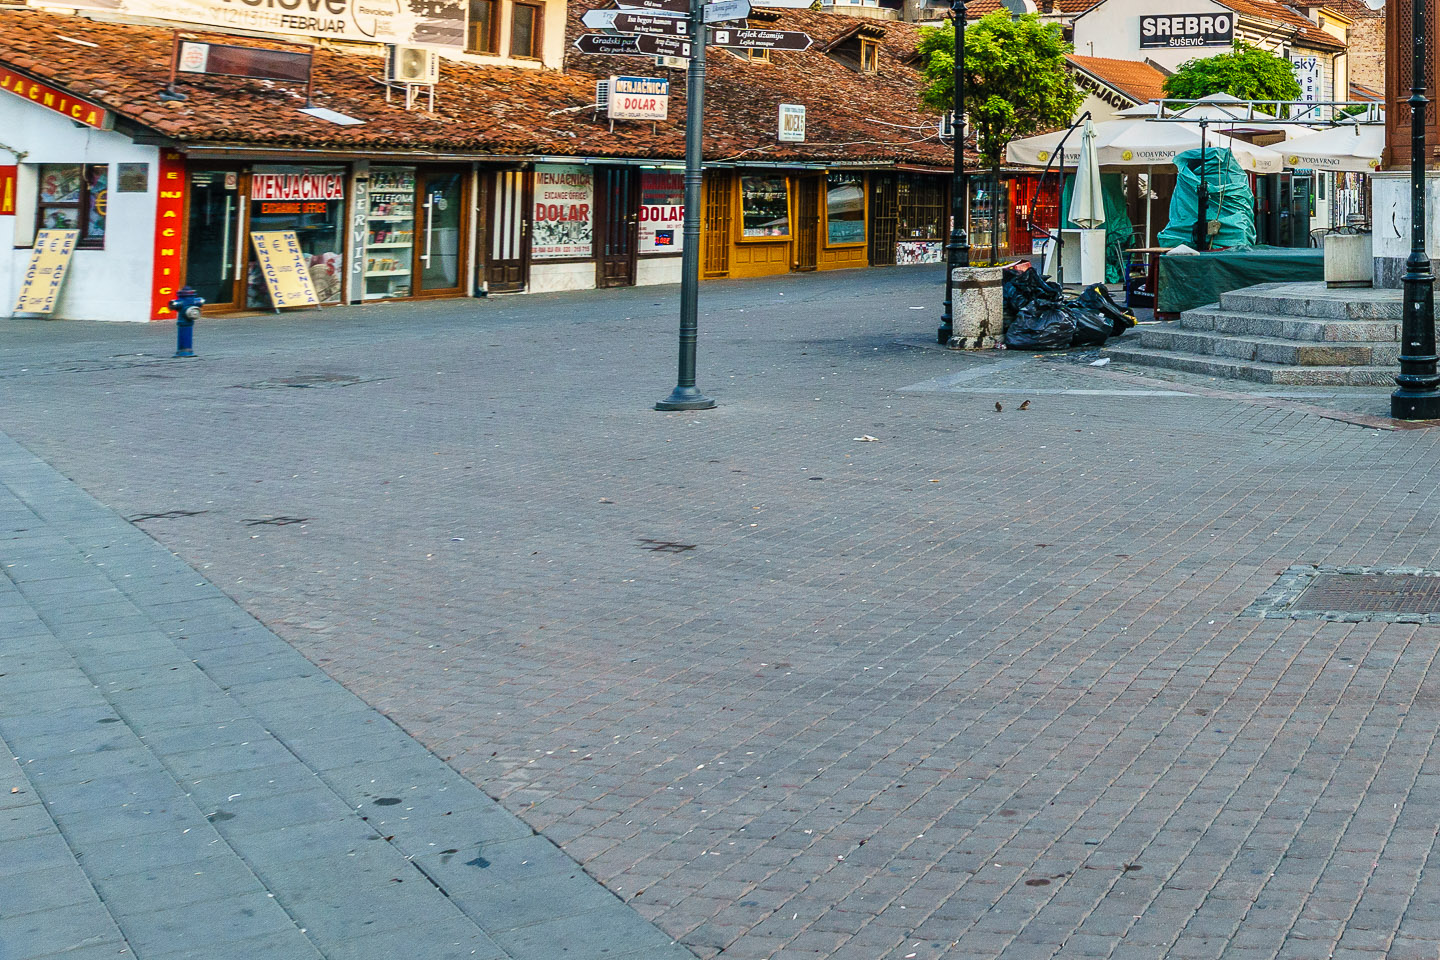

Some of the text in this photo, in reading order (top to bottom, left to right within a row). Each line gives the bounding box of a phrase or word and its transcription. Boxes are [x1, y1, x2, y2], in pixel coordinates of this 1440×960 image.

[281, 14, 346, 34] FEBRUAR
[1142, 15, 1230, 37] SREBRO
[592, 36, 637, 47] Gradski par
[737, 30, 784, 41] Lejlek džamija
[1169, 35, 1204, 47] ŠUŠEVIĆ
[616, 78, 667, 95] MENJAČNICA
[1074, 71, 1135, 111] MENJACN
[624, 97, 656, 111] DOLAR
[1154, 150, 1176, 159] VRNJCI
[1319, 158, 1340, 166] VRNJCI
[251, 170, 345, 201] MENJAČNICA
[371, 193, 414, 204] TELEFONA
[569, 191, 587, 200] OFFICE
[536, 202, 590, 222] DOLAR
[353, 182, 366, 274] SERVIS
